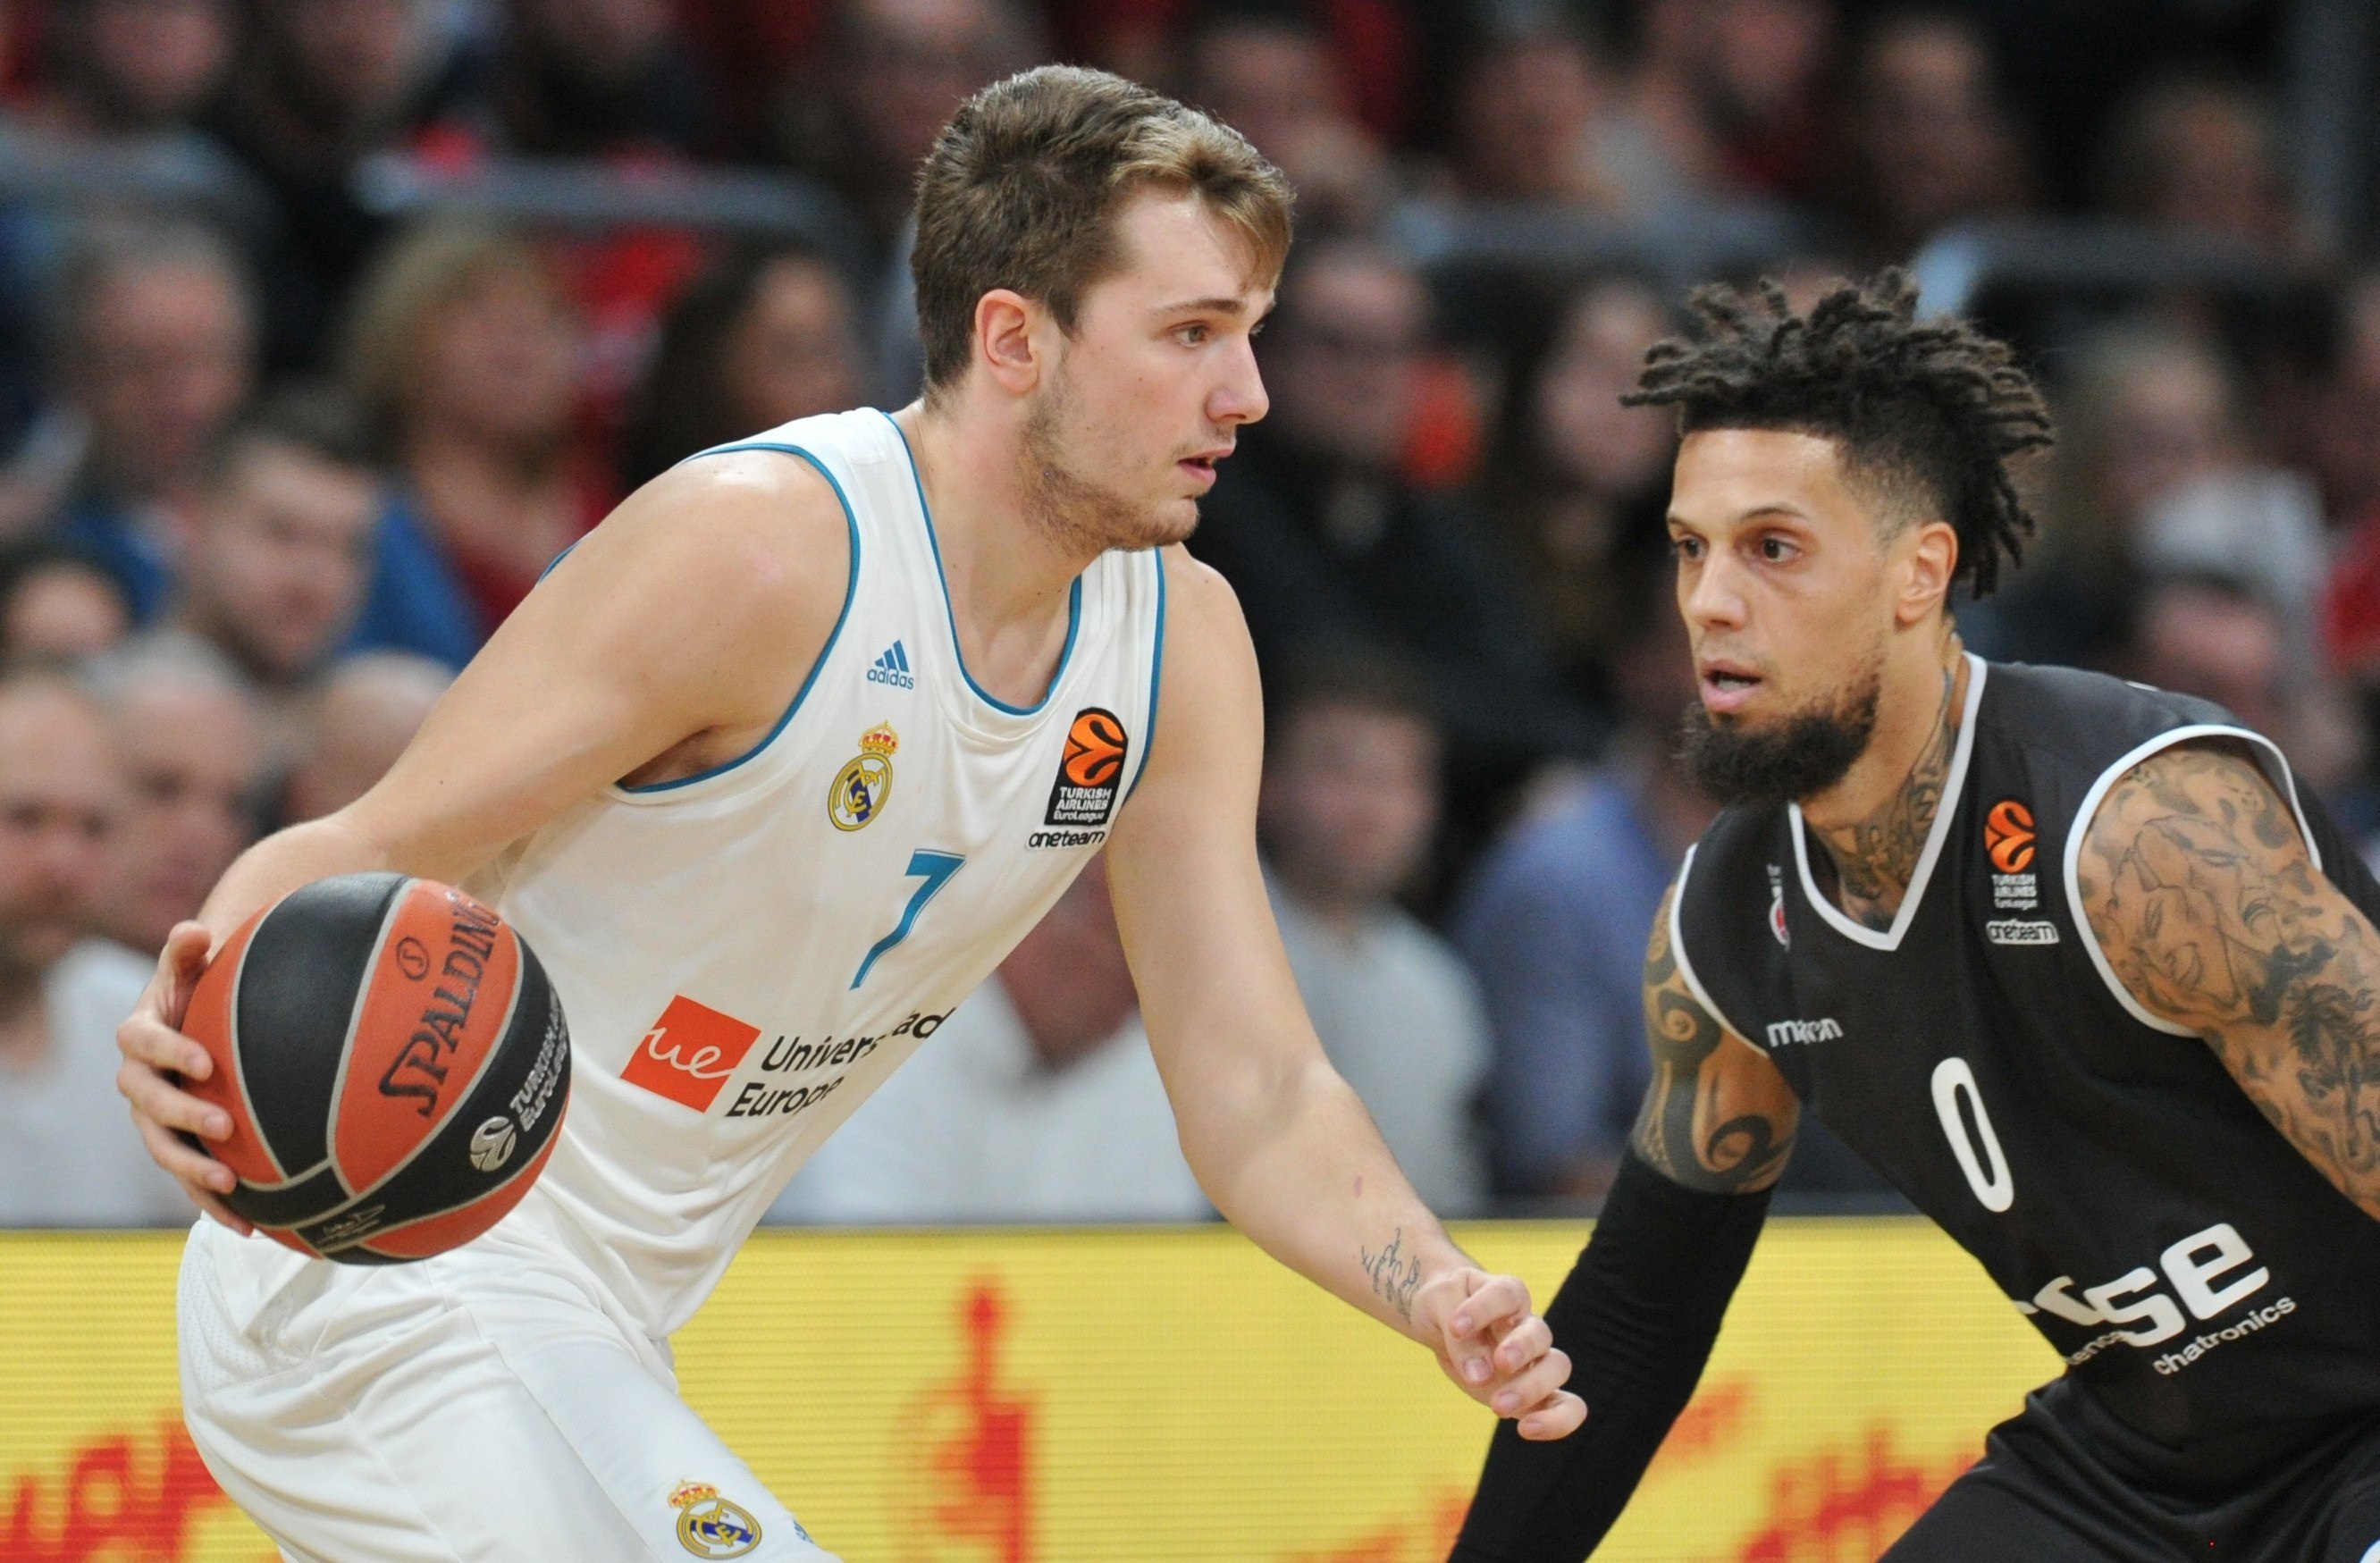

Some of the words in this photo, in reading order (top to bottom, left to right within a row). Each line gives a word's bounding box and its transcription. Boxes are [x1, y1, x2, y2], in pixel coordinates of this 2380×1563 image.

[867, 667, 914, 691] adidas
[1055, 798, 1109, 811] AIRLINES
[1059, 786, 1113, 800] TURKISH
[1029, 829, 1106, 848] oneteam
[849, 848, 967, 991] 7
[378, 891, 501, 1119] SPALDING
[1930, 1056, 2014, 1213] 0
